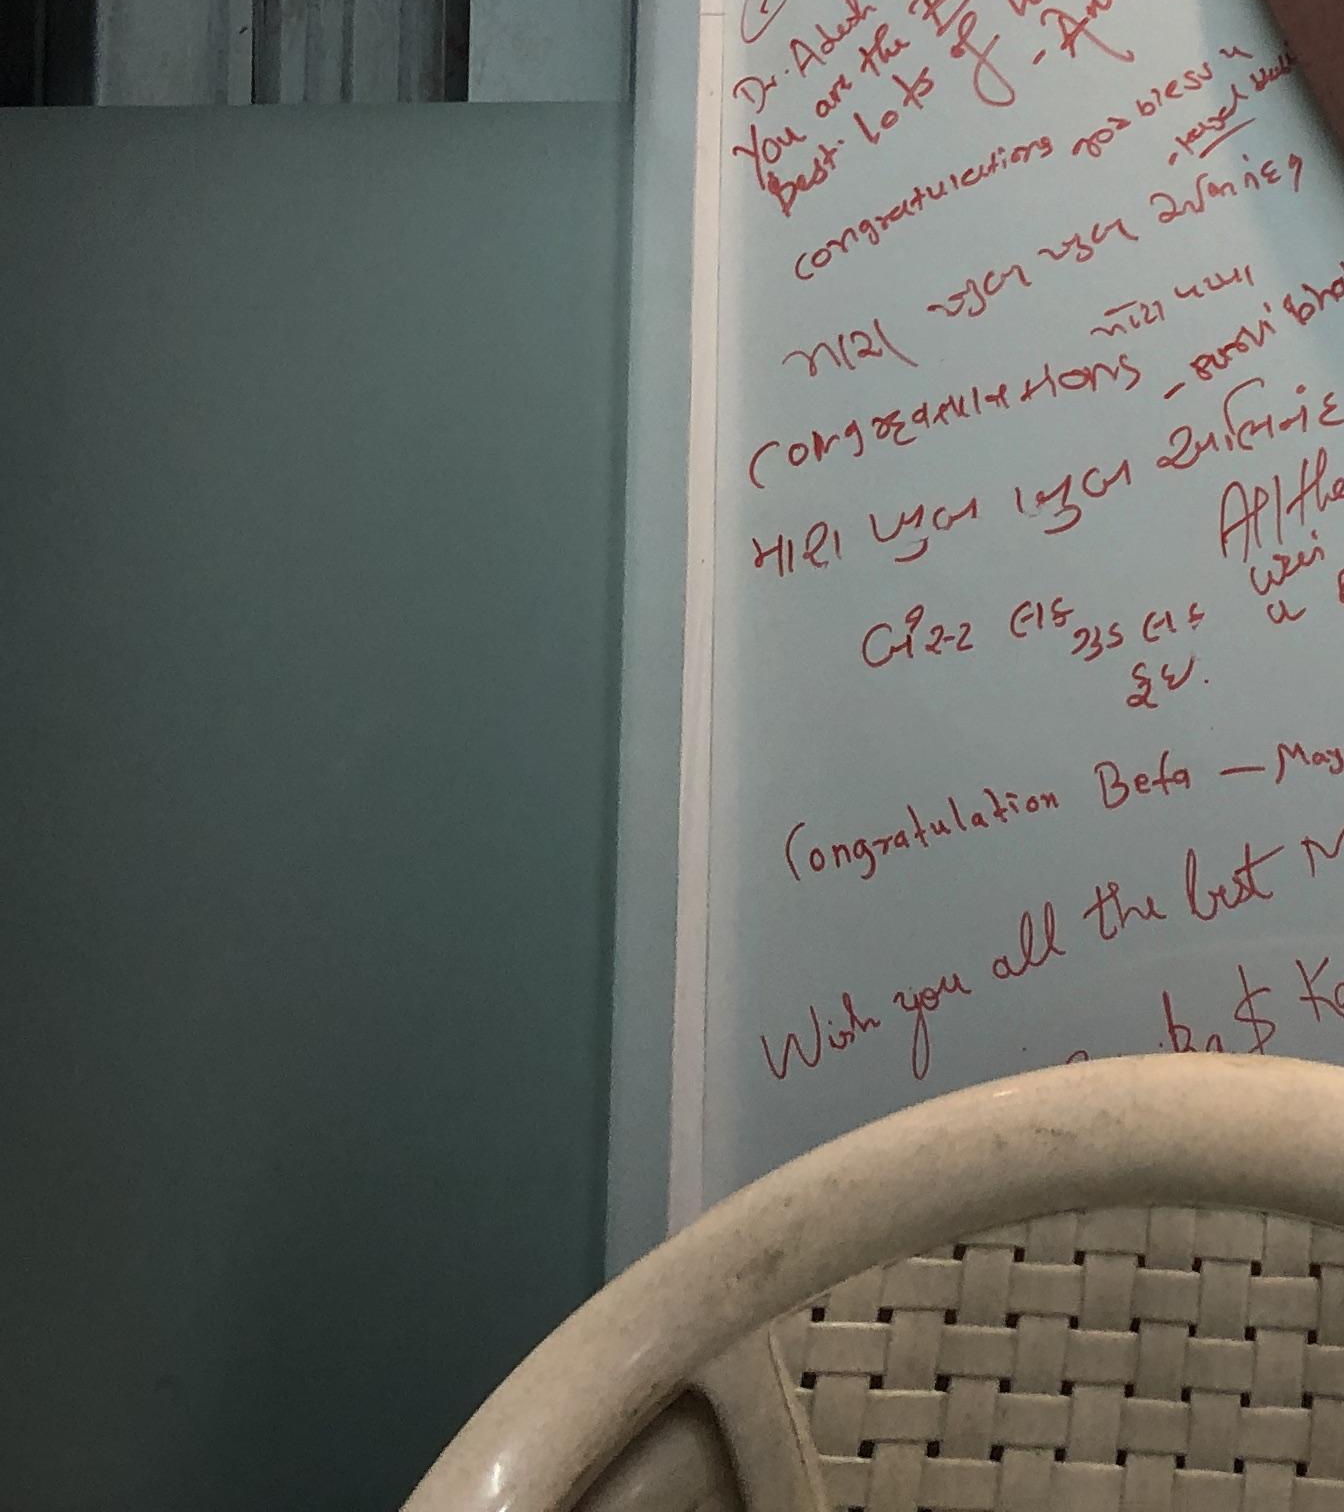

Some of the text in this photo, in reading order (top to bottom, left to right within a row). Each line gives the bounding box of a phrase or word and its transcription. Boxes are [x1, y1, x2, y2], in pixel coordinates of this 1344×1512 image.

[859, 23, 910, 75] the
[785, 788, 1060, 882] Congratulation
[762, 991, 882, 1080] Wish
[892, 973, 973, 1080] you
[991, 909, 1069, 981] all
[1084, 881, 1168, 942] the
[1184, 842, 1287, 922] best
